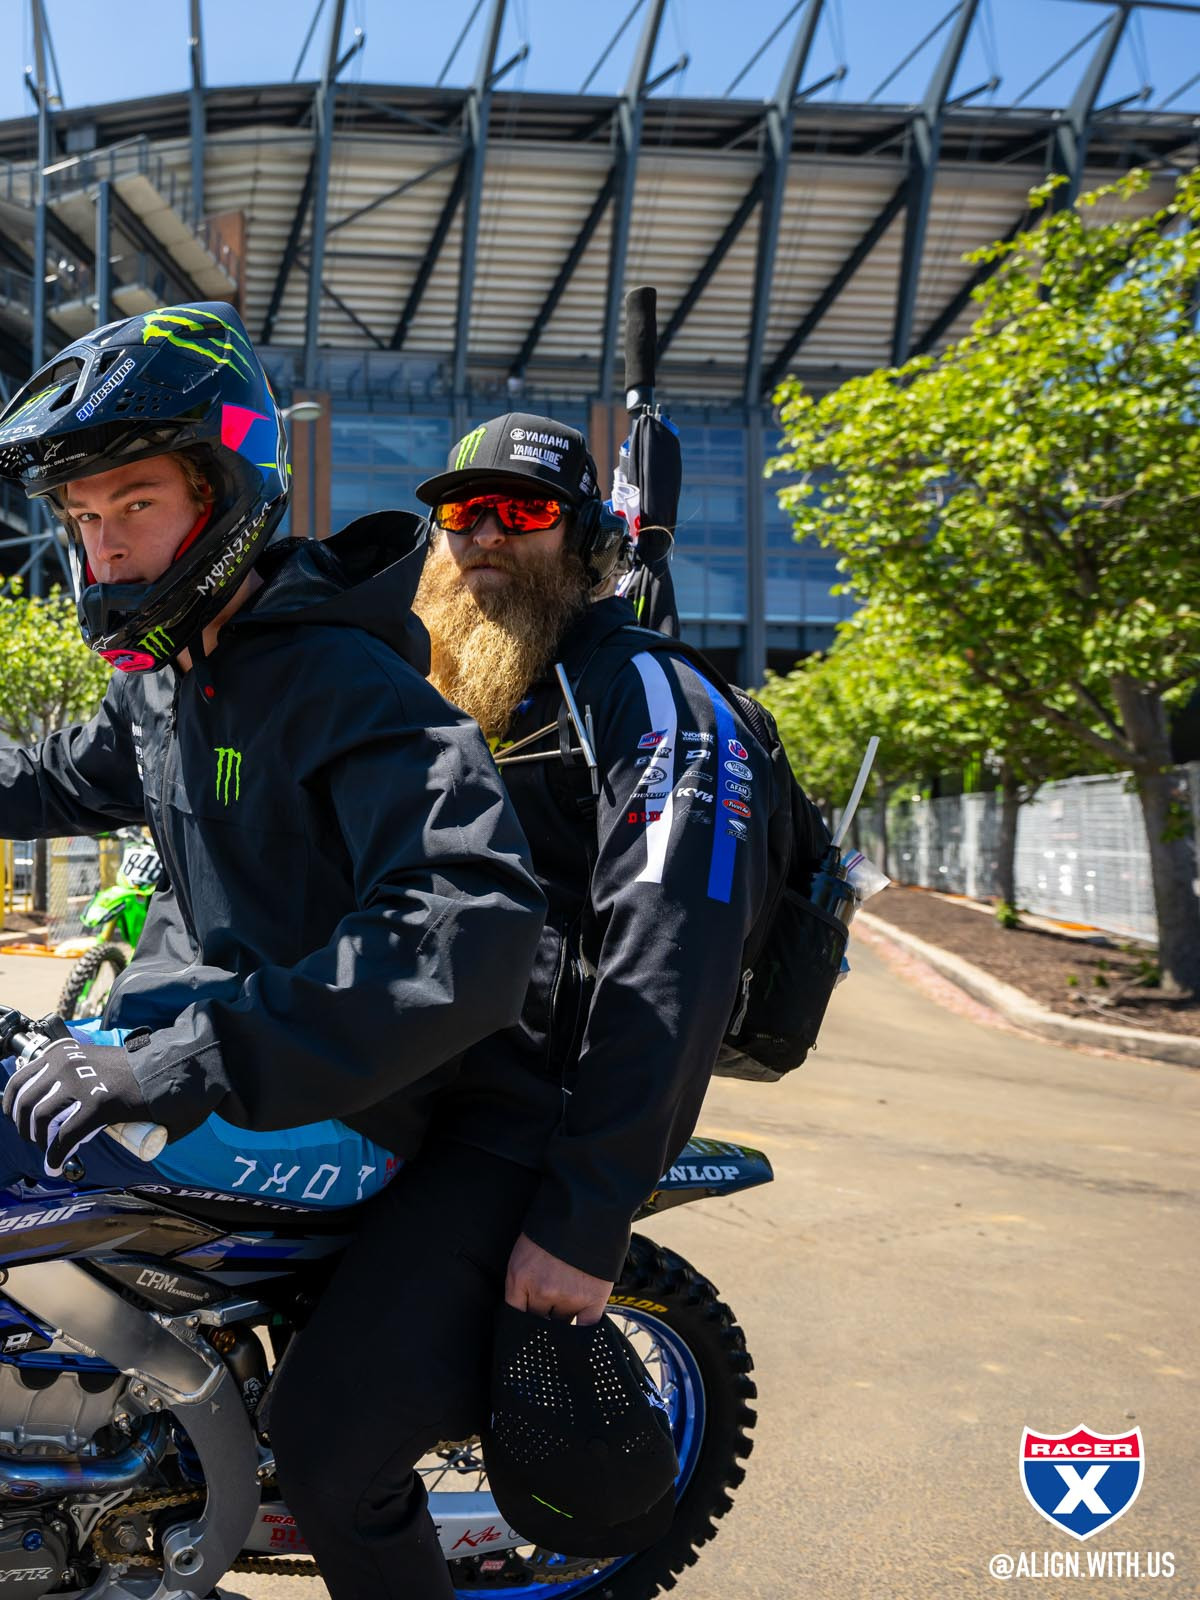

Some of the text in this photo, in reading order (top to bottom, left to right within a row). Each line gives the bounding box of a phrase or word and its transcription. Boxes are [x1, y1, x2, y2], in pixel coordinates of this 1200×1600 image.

[76, 358, 136, 422] apdesigns
[526, 431, 569, 451] YAMAHA
[513, 444, 561, 466] YAMALUBE
[676, 787, 714, 803] KYB
[730, 784, 748, 796] AFAM
[659, 1165, 740, 1182] NLOP
[607, 1295, 669, 1313] NLOP
